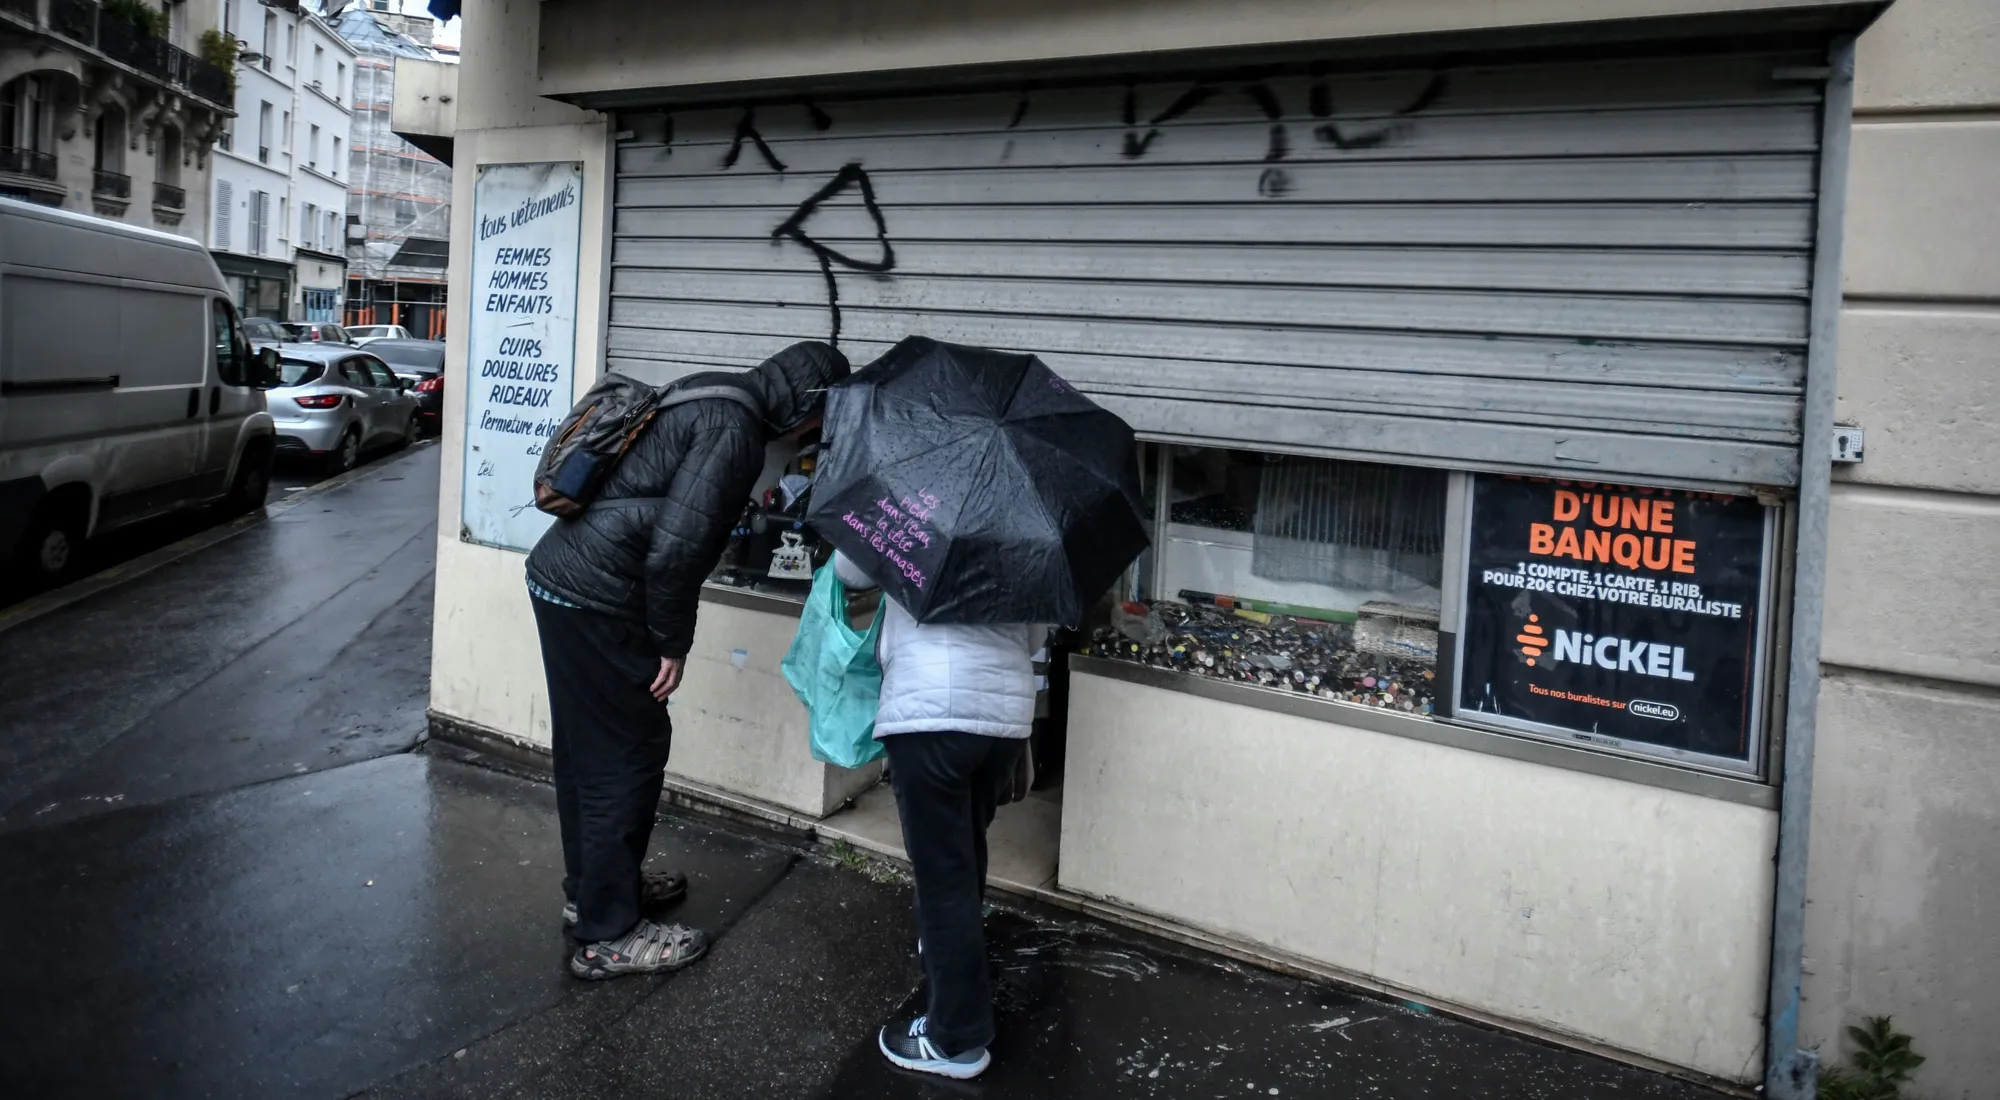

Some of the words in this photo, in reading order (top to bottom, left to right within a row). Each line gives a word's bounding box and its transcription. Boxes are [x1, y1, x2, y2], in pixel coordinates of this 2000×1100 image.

[480, 213, 507, 241] tous
[494, 247, 552, 267] FEMMES
[488, 270, 548, 290] HOMMES
[485, 293, 553, 314] ENFANTS
[498, 336, 543, 359] CUIRS
[481, 359, 559, 383] DOUBLURES
[488, 384, 553, 408] RIDEAUX
[479, 408, 534, 436] fermeture
[876, 496, 906, 524] dans
[918, 486, 940, 510] Les
[1553, 489, 1675, 534] D'UNE
[875, 515, 888, 532] la
[842, 510, 869, 538] dans
[869, 530, 887, 553] les
[885, 548, 926, 588] nuages
[1529, 522, 1697, 574] BANQUE
[1483, 570, 1525, 589] POUR
[1526, 577, 1556, 593] 20€
[1557, 581, 1596, 599] CHEZ
[1597, 586, 1649, 606] VOTRE
[1650, 593, 1742, 619] BURALISTE
[1518, 561, 1526, 575] 1
[1527, 563, 1593, 585] COMPTE,
[1594, 572, 1603, 586] 1
[1604, 573, 1659, 594] CARTE,
[1660, 581, 1670, 595] 1
[1671, 581, 1704, 600] RIB,
[1528, 683, 1549, 696] Tous
[1550, 688, 1566, 699] nos
[1567, 691, 1611, 708] buralistes
[1612, 700, 1627, 710] sur
[1633, 703, 1675, 717] nickel.eu
